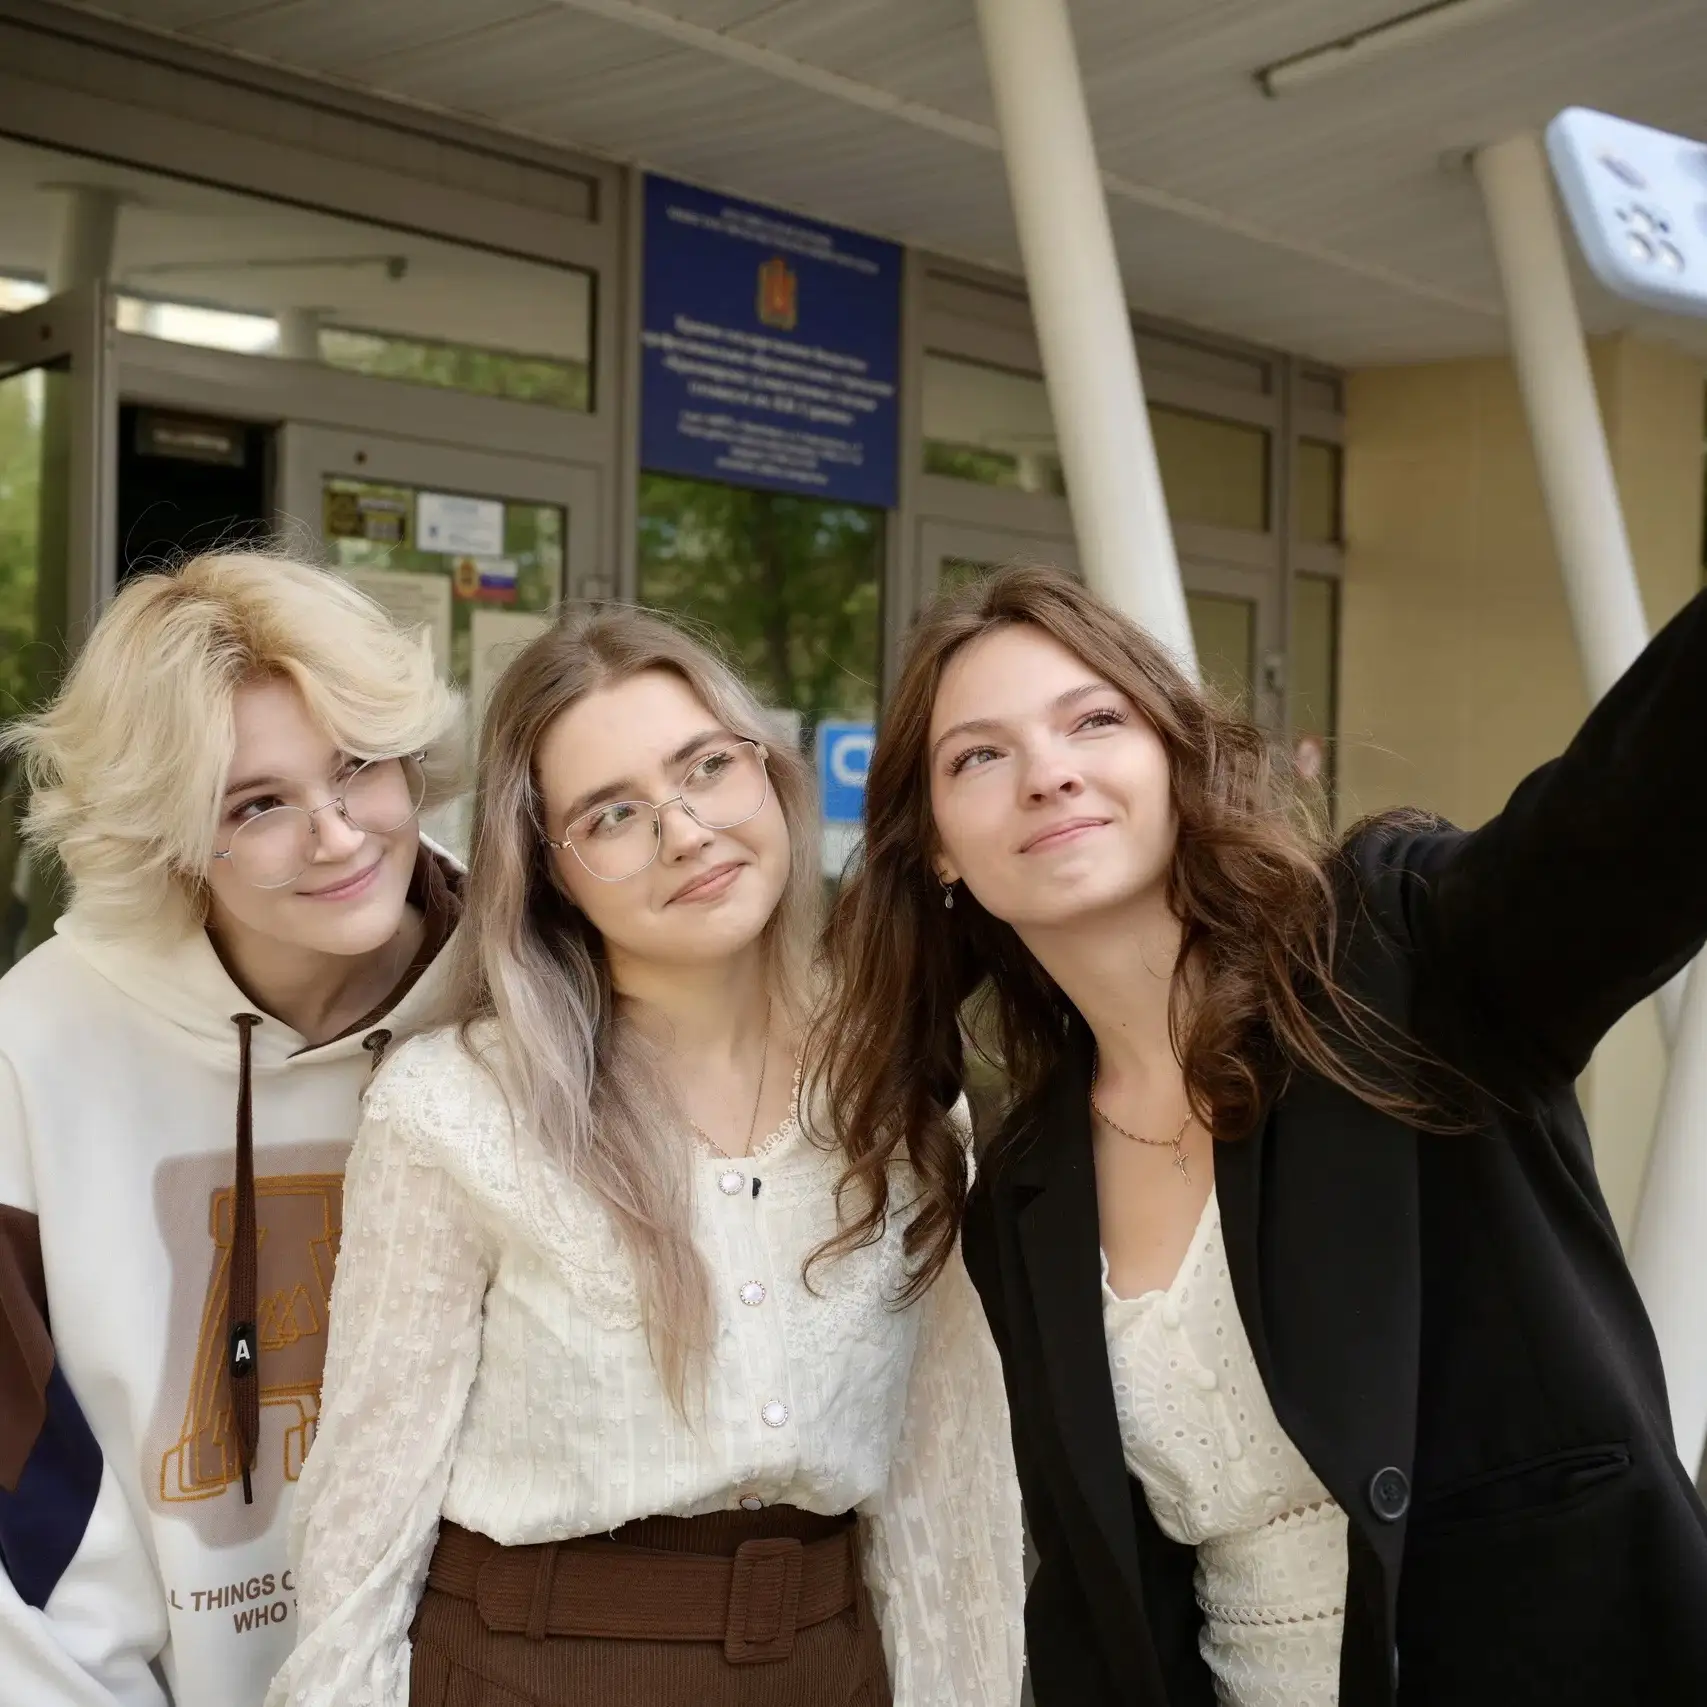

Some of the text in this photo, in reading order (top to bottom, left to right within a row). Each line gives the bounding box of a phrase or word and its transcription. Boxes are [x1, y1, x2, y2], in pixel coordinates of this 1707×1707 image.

[235, 1339, 251, 1362] A
[190, 1574, 276, 1612] THINGS
[233, 1601, 288, 1634] WHO
